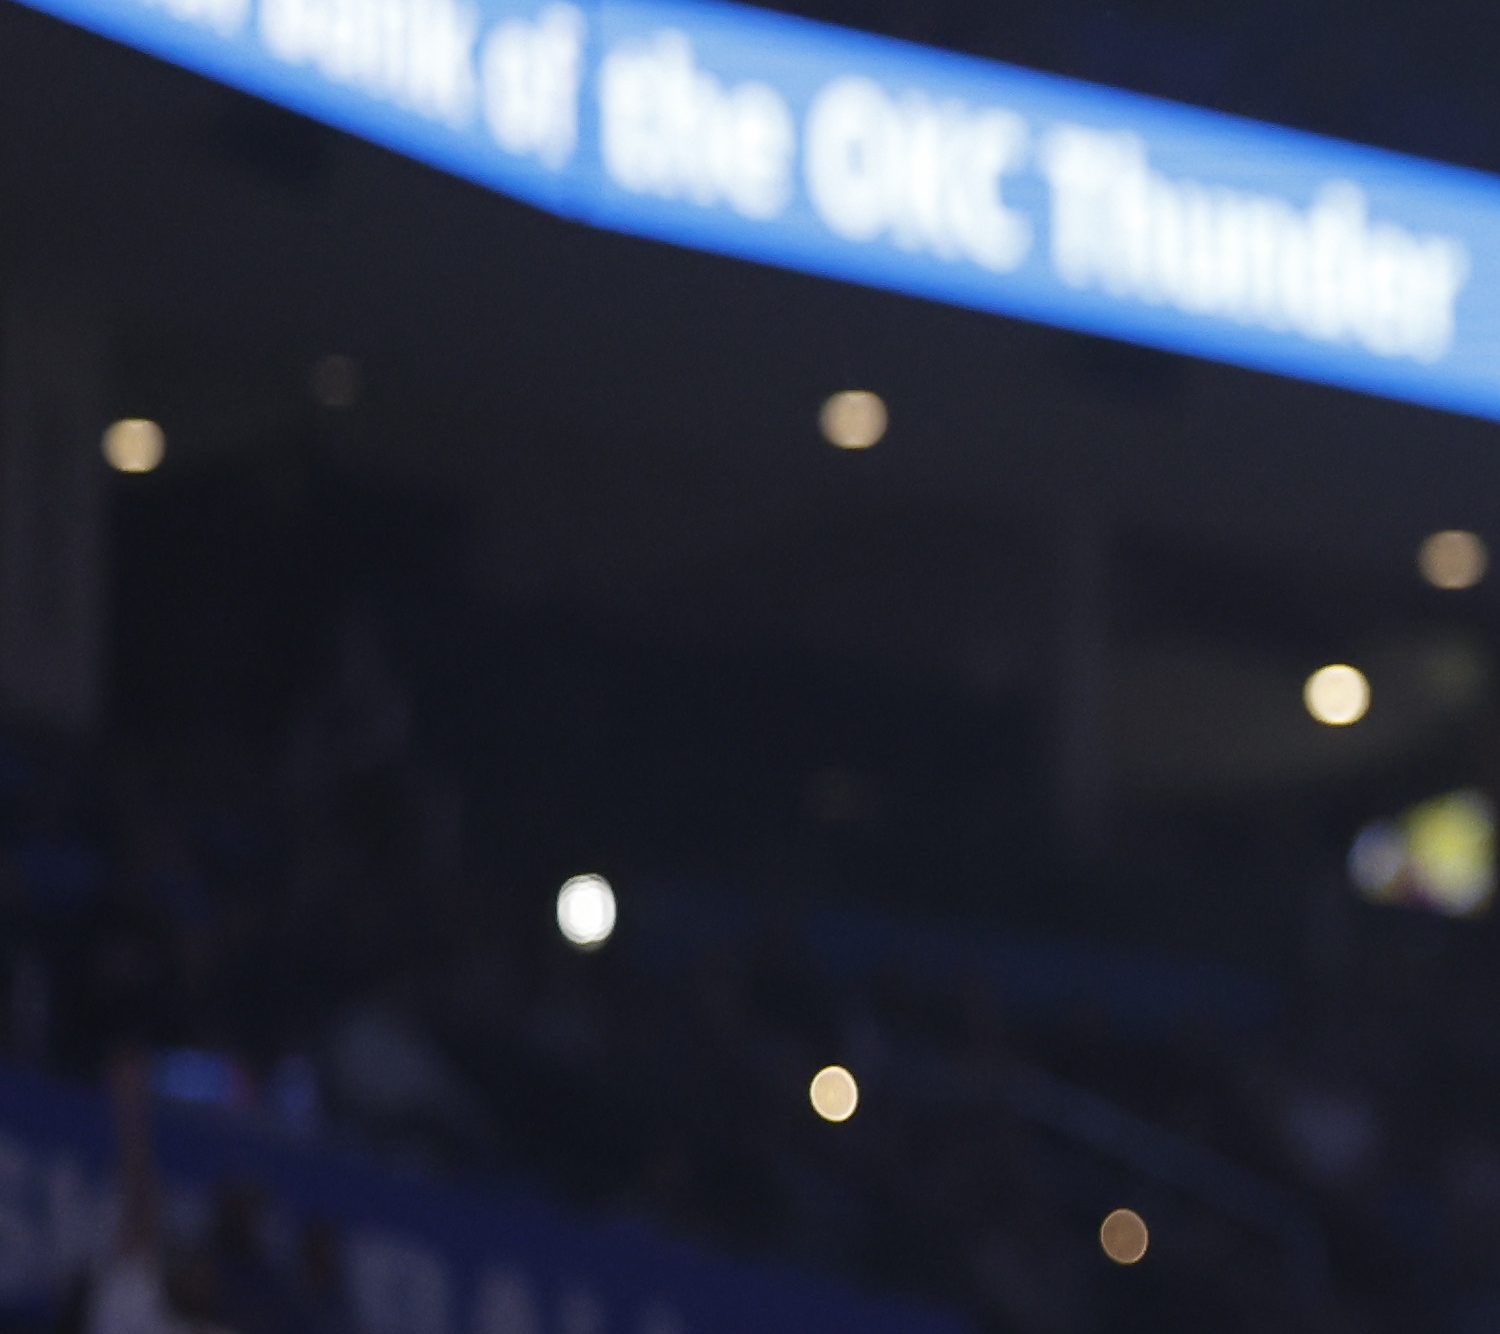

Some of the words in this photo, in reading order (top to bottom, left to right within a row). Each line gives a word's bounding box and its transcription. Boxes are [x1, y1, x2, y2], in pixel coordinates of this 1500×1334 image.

[482, 0, 588, 170] of
[601, 28, 794, 221] the
[806, 74, 1033, 271] OKC
[1042, 122, 1470, 364] Thunder
